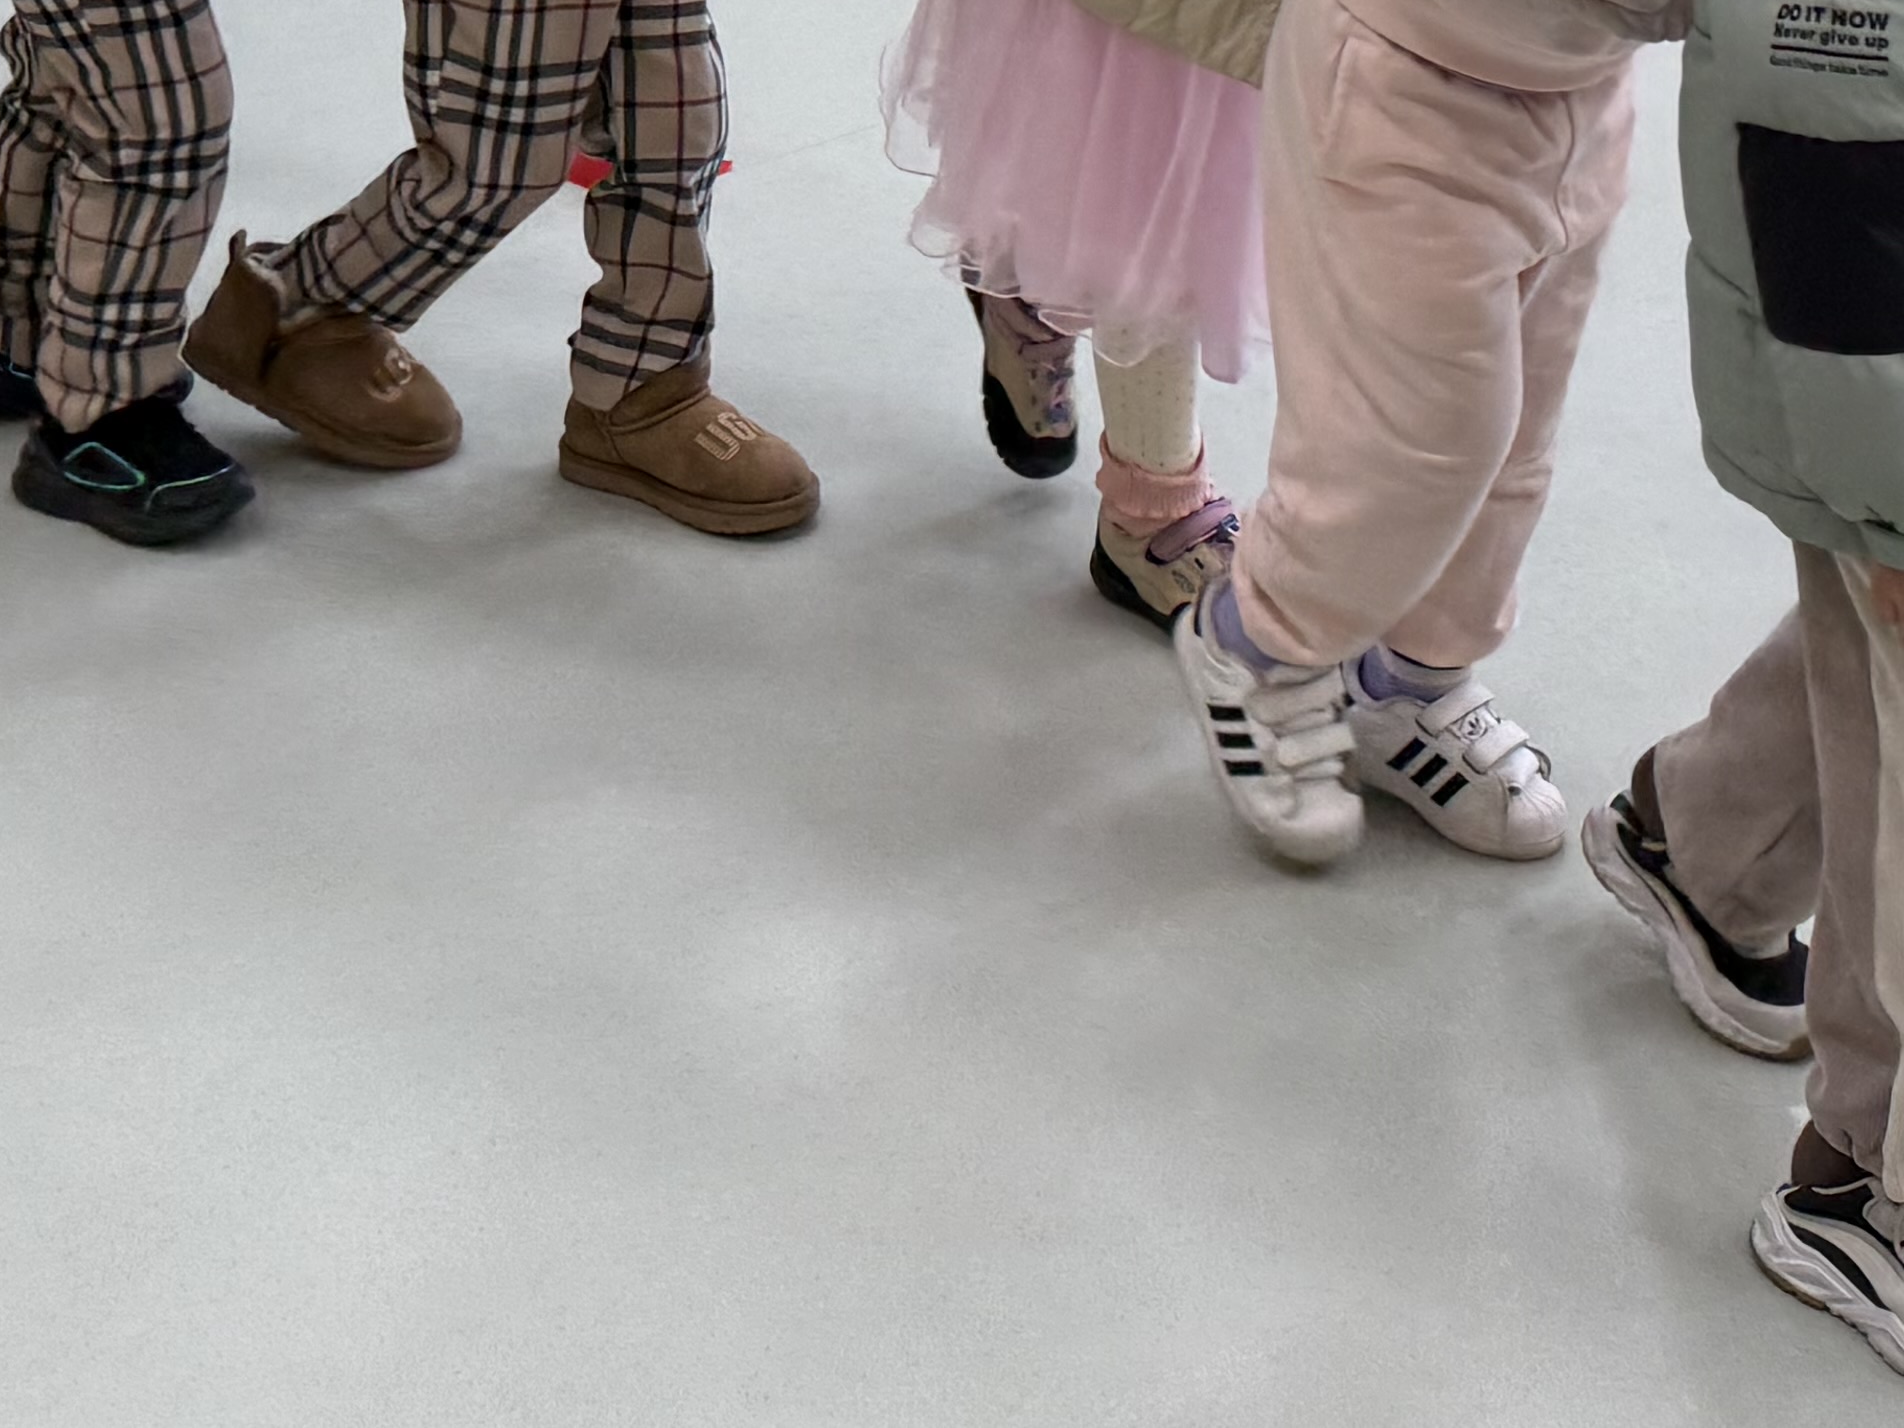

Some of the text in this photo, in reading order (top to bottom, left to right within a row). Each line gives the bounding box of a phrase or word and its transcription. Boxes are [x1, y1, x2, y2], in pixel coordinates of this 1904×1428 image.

[1777, 3, 1890, 31] DO IT NOW
[1773, 22, 1889, 52] Never give up
[694, 411, 765, 461] UG
